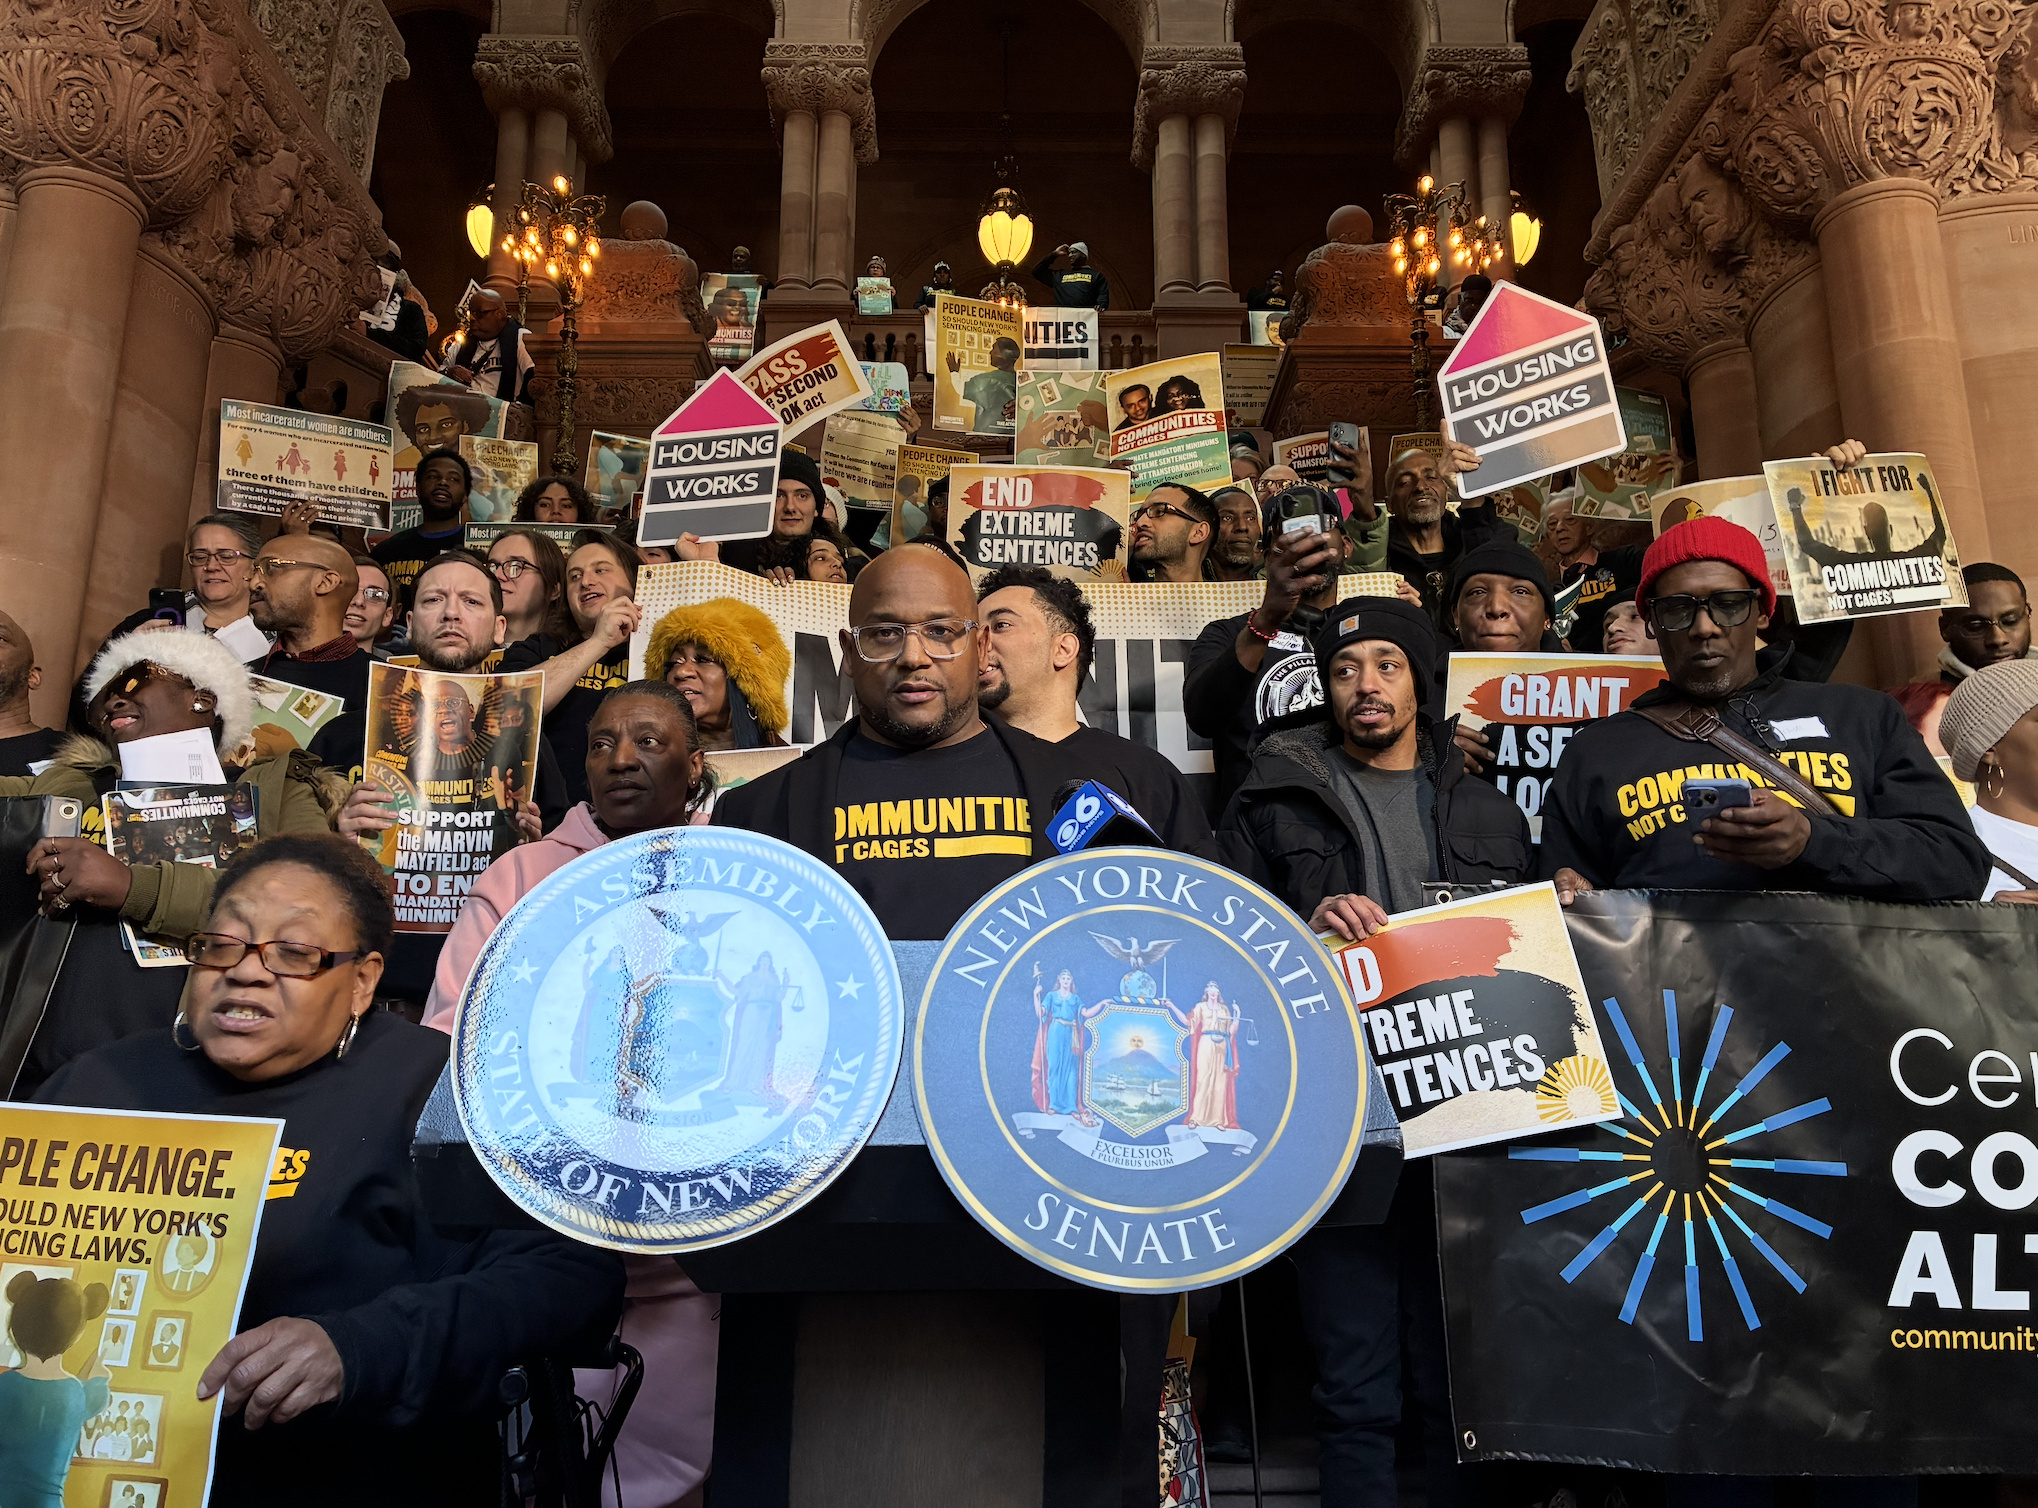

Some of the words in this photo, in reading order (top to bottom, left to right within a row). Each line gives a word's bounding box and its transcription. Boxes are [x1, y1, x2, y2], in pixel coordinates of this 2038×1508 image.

[943, 302, 977, 317] PEOPLE
[978, 308, 1018, 324] CHANGE.
[952, 317, 979, 326] SHOULD
[979, 321, 994, 329] NEW
[995, 323, 1018, 333] YORK'S
[942, 322, 982, 333] SENTENCING
[983, 328, 1003, 336] LAWS.
[748, 349, 808, 394] PASS
[774, 363, 838, 404] SECOND
[1452, 339, 1597, 407] HOUSING
[803, 391, 827, 412] act
[1474, 385, 1591, 439] WORKS
[226, 405, 251, 421] Most
[252, 409, 306, 429] incarcerated
[306, 420, 338, 435] women
[338, 425, 353, 436] are
[353, 428, 389, 444] mothers.
[239, 425, 258, 433] every
[263, 429, 287, 437] women
[313, 437, 354, 448] incarcerated
[1117, 412, 1217, 446] COMMUNITIES
[657, 434, 775, 466] HOUSING
[1117, 443, 1136, 452] NOT
[1137, 433, 1166, 447] CAGES
[1149, 444, 1185, 458] MANDATORY
[1185, 437, 1220, 451] MINIMUMS
[1291, 442, 1330, 460] SUPPO
[1396, 438, 1424, 449] PEOPLE
[904, 450, 935, 464] PEOPLE
[911, 462, 936, 471] SHOULD
[937, 465, 950, 473] NEW
[1148, 460, 1204, 479] TRANSFORMATION
[1159, 451, 1198, 466] SENTENCING
[226, 468, 259, 482] three
[261, 473, 274, 482] of
[275, 475, 308, 488] them
[308, 480, 340, 492] have
[338, 484, 389, 499] children.
[824, 466, 845, 479] before
[846, 472, 857, 482] we
[857, 475, 868, 484] are
[868, 478, 896, 490] reunited
[902, 467, 935, 477] SENTENCING
[1134, 480, 1152, 489] bring
[1153, 477, 1164, 485] our
[1164, 473, 1184, 483] loved
[1184, 469, 1200, 477] ones
[1200, 464, 1223, 474] home!
[1811, 470, 1821, 496] I
[1820, 467, 1876, 496] FIGHT
[1877, 465, 1914, 492] FOR
[232, 483, 254, 492] There
[268, 488, 309, 499] thousands
[318, 495, 352, 506] mothers
[371, 502, 381, 510] are
[665, 472, 760, 499] WORKS
[982, 477, 1033, 507] END
[232, 491, 269, 505] currently
[327, 503, 347, 514] their
[346, 508, 378, 518] children
[249, 503, 266, 512] cage
[470, 528, 490, 539] Most
[980, 511, 1076, 537] EXTREME
[978, 538, 1099, 567] SENTENCES
[1822, 556, 1947, 593] COMMUNITIES
[1827, 592, 1853, 611] NOT
[1855, 590, 1893, 607] CAGES
[1273, 666, 1288, 681] THE
[1500, 674, 1630, 718] GRANT
[1497, 725, 1519, 767] A
[1525, 726, 1585, 769] SE
[1616, 751, 1854, 817] COMTIES
[183, 797, 208, 805] CAGES
[208, 795, 225, 803] NOT
[1076, 793, 1101, 824] 6
[141, 802, 226, 822] COMMUNITIES
[397, 809, 495, 828] SUPPORT
[1084, 810, 1105, 831] NEWS
[1626, 809, 1667, 841] NOT
[397, 828, 420, 851] the
[424, 830, 493, 852] MARVIN
[853, 837, 930, 859] CAGES
[395, 851, 470, 872] MAYFIELD
[472, 854, 491, 869] act
[394, 872, 431, 895] TO
[437, 875, 479, 896] EN
[574, 857, 837, 936] ASSEMBLY
[953, 886, 1049, 989] NEW
[1055, 864, 1208, 913] YORK
[1212, 895, 1331, 1020] STATE
[1376, 1033, 1547, 1108] TENCES
[1889, 1028, 2038, 1109] Ce
[1090, 1150, 1097, 1158] E
[1097, 1152, 1142, 1168] PLURIBUS
[1144, 1157, 1175, 1168] UNUM
[1095, 1140, 1174, 1159] EXCELSIOR
[0, 1136, 69, 1188] PLE
[69, 1142, 237, 1200] CHANGE.
[1891, 1129, 2038, 1211] CO
[560, 1159, 632, 1209] OF
[637, 1169, 757, 1216] NEW
[61, 1203, 128, 1232] NEW
[131, 1206, 230, 1239] YORK'S
[1023, 1192, 1237, 1265] SENATE
[0, 1228, 67, 1258] CING
[69, 1233, 153, 1265] LAWS.
